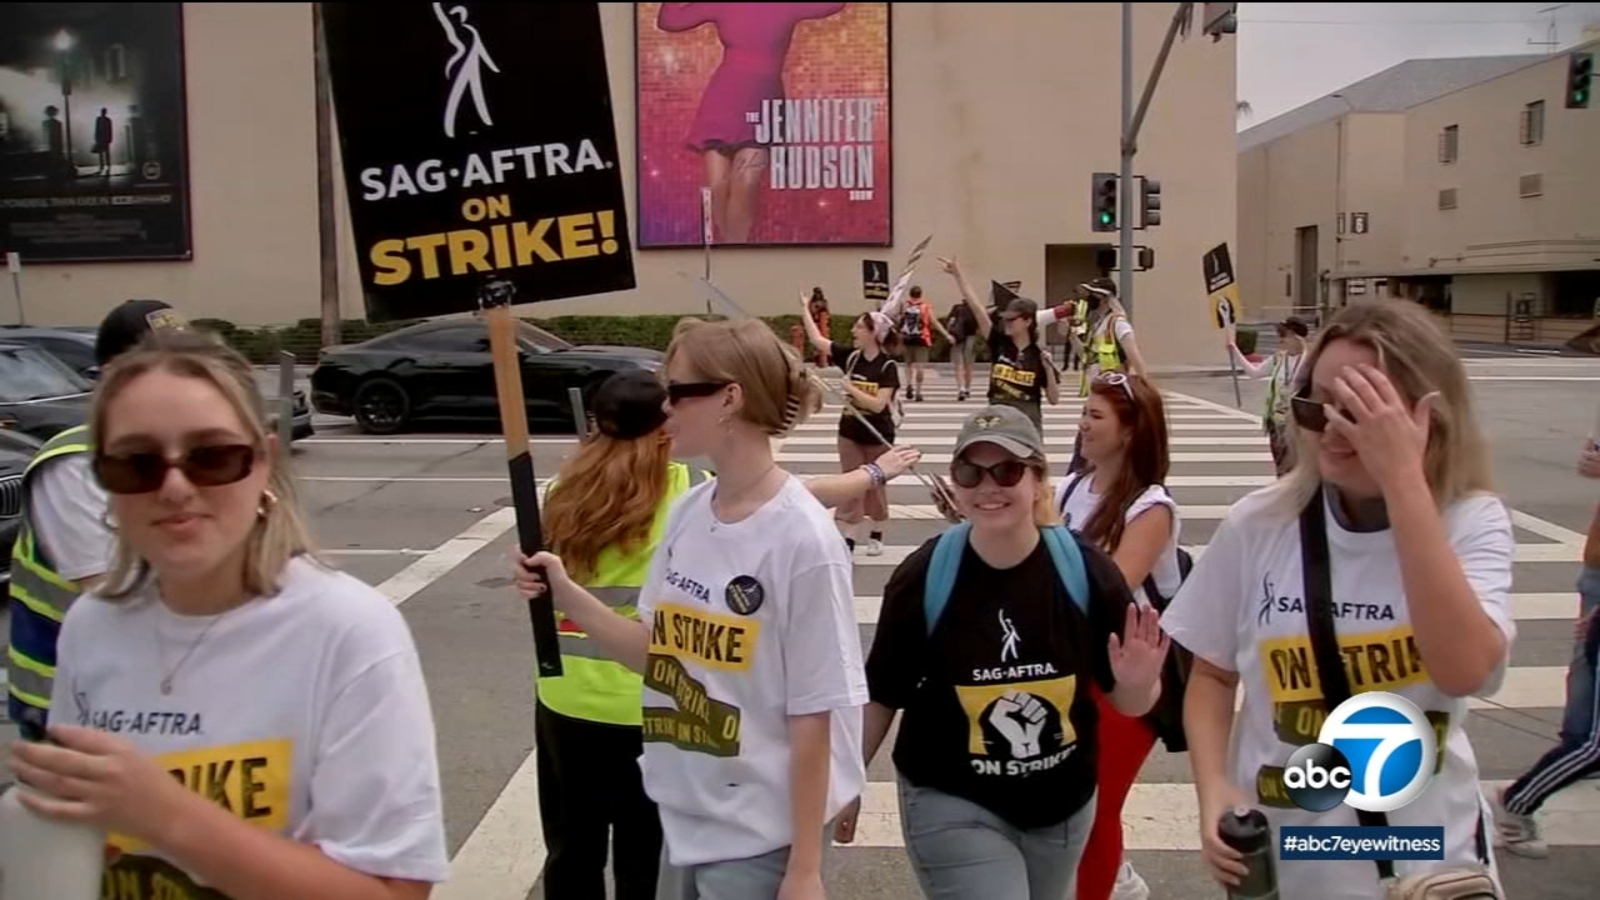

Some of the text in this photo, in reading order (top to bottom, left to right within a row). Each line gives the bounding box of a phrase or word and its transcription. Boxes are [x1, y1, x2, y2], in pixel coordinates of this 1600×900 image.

[755, 99, 873, 143] JENNIFER
[770, 145, 874, 190] HUDSON
[462, 194, 512, 222] ON
[370, 210, 619, 285] STRIKE!
[1341, 636, 1423, 686] TRIK
